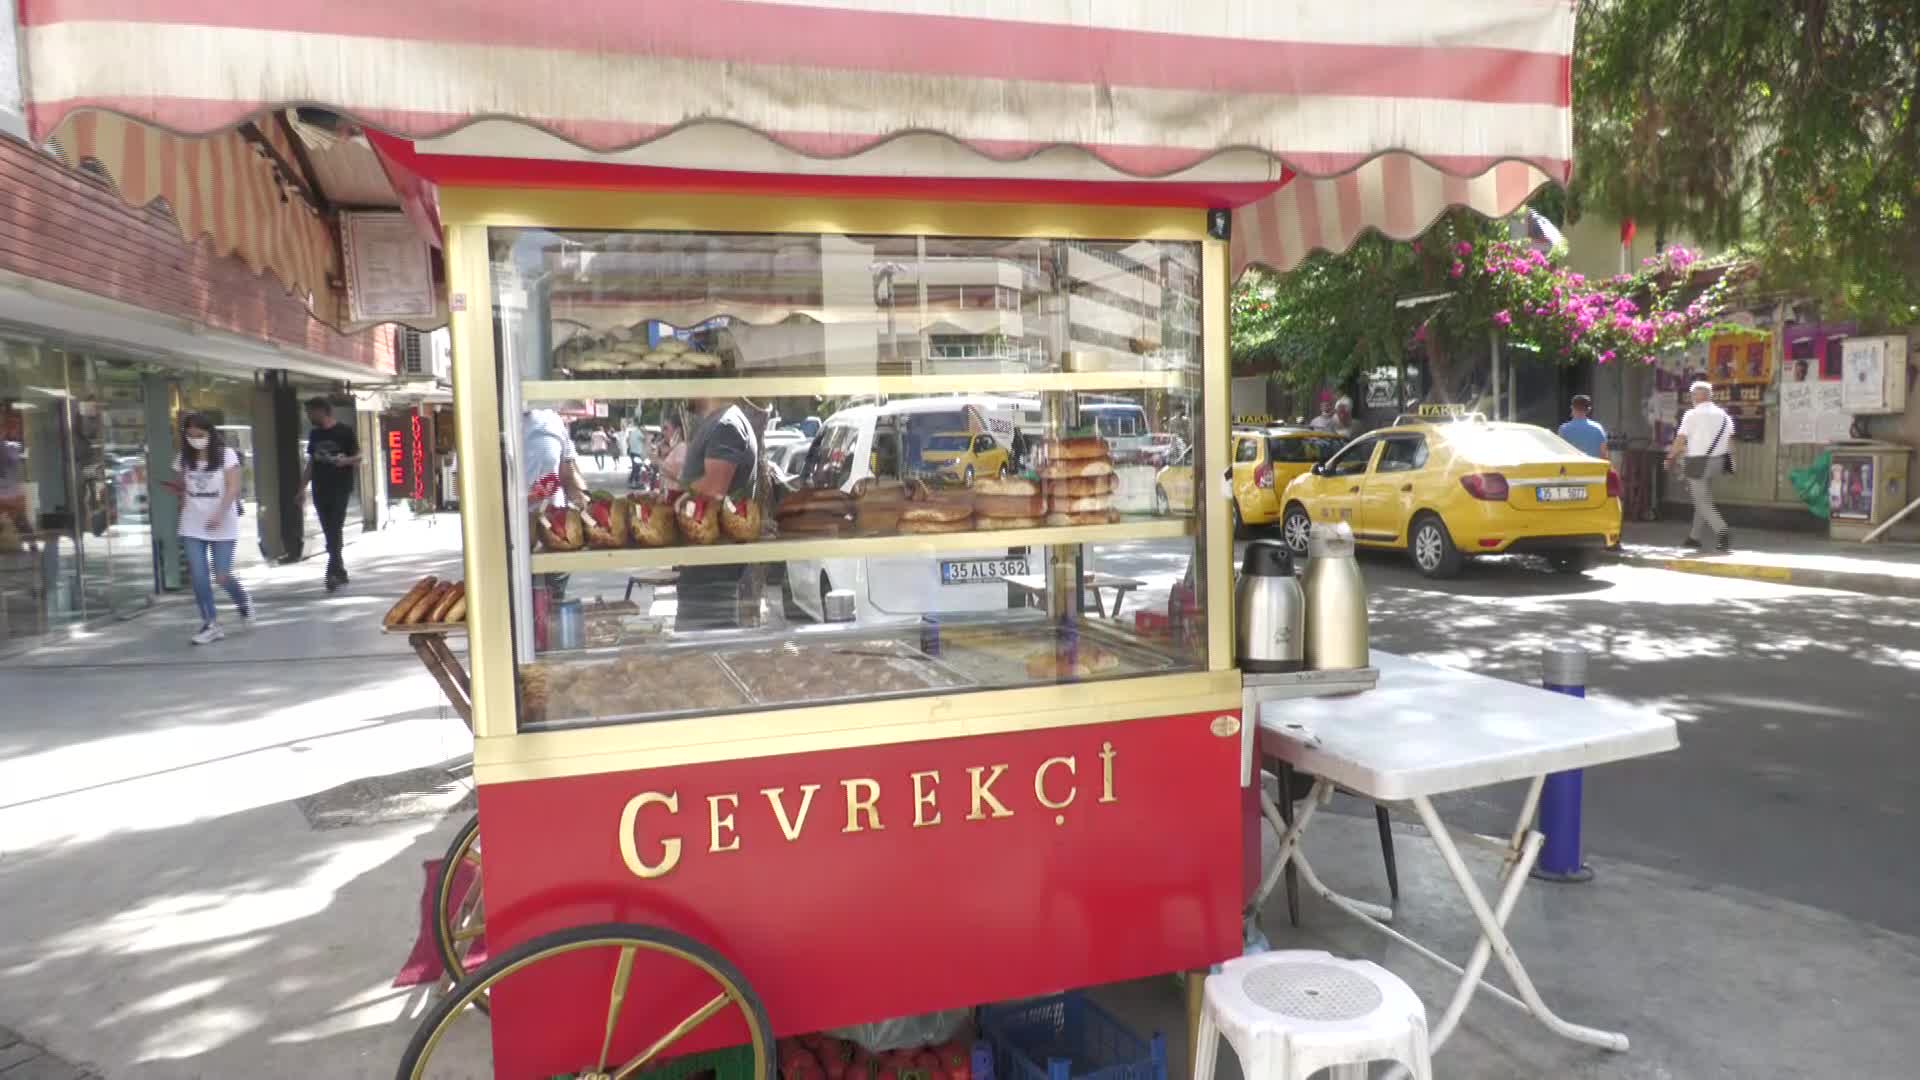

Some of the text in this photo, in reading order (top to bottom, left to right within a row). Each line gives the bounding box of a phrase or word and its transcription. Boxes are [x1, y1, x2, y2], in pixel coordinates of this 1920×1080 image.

[389, 430, 403, 483] EFE
[952, 560, 1025, 578] 35 ALS 362
[618, 741, 1118, 878] GEVREKÇİ
